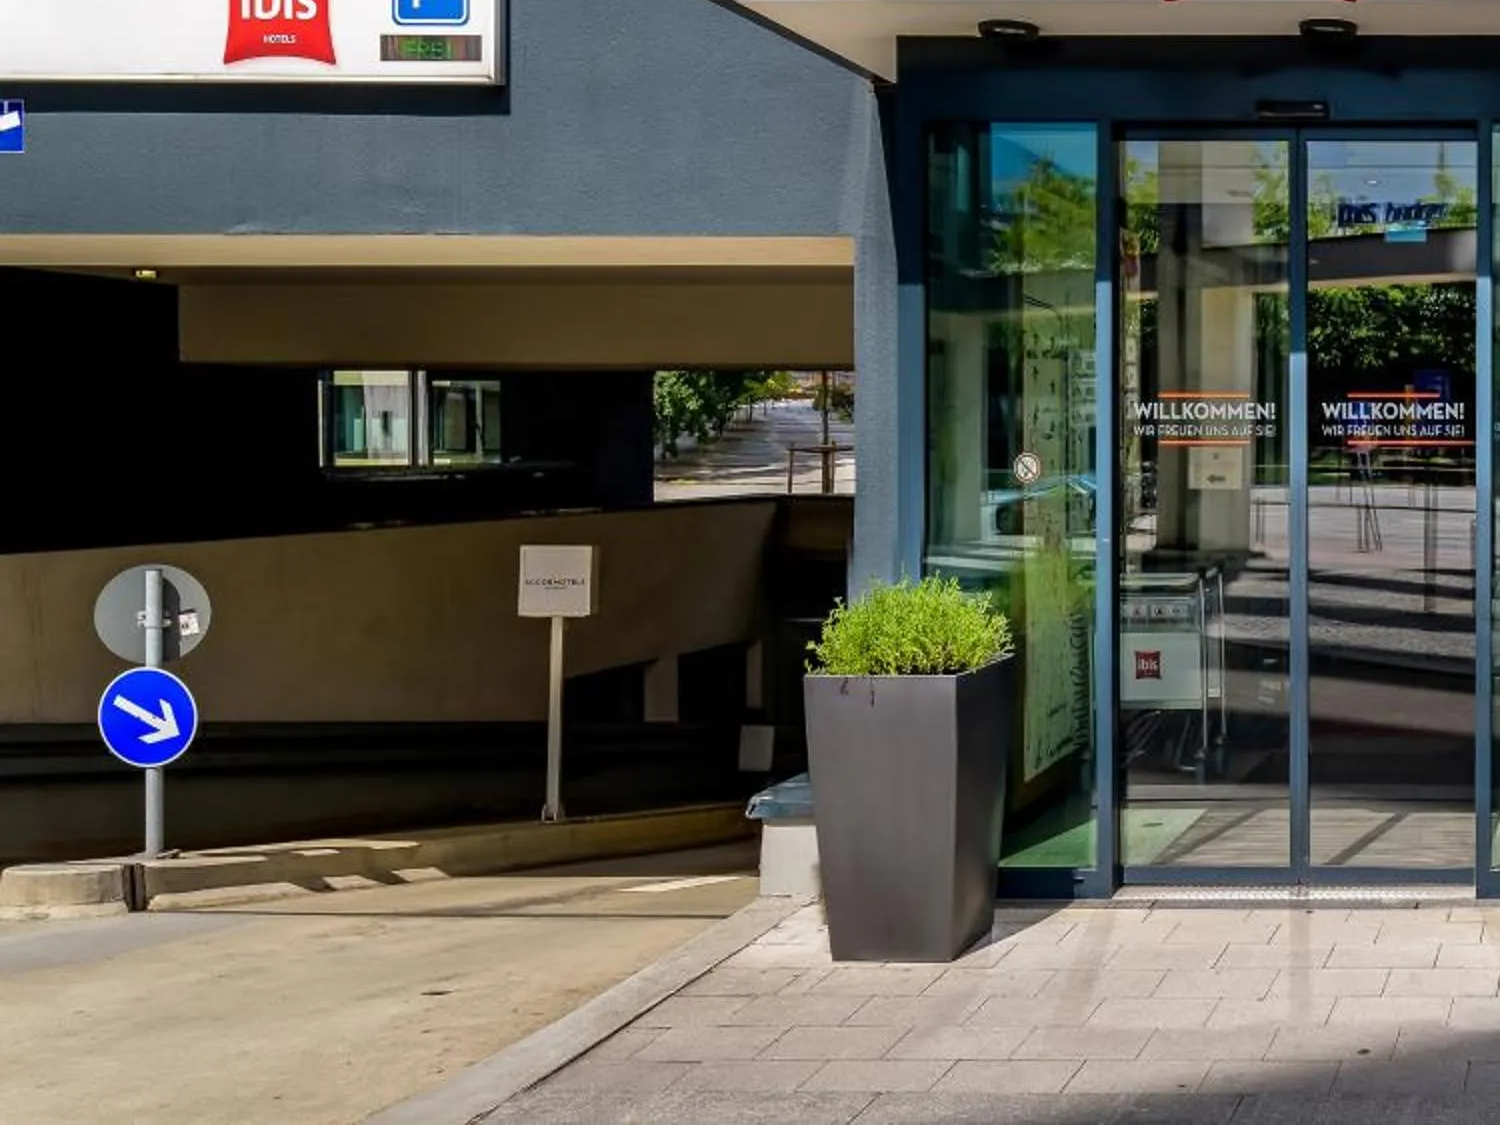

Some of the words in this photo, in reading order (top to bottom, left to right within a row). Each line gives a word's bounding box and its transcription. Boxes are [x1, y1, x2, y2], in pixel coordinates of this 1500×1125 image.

[263, 34, 297, 44] HOTELS
[1133, 402, 1276, 420] WILLKOMMEN!
[1321, 402, 1465, 420] WILLKOMMEN!
[1133, 425, 1155, 436] WIR
[1157, 425, 1203, 436] FREUEN
[1205, 425, 1229, 436] UNS
[1231, 425, 1252, 436] AUF
[1321, 425, 1344, 436] WIR
[1347, 425, 1391, 436] FREUEN
[1394, 425, 1417, 436] UNS
[1419, 425, 1442, 436] AUF
[1443, 425, 1465, 436] SIE!
